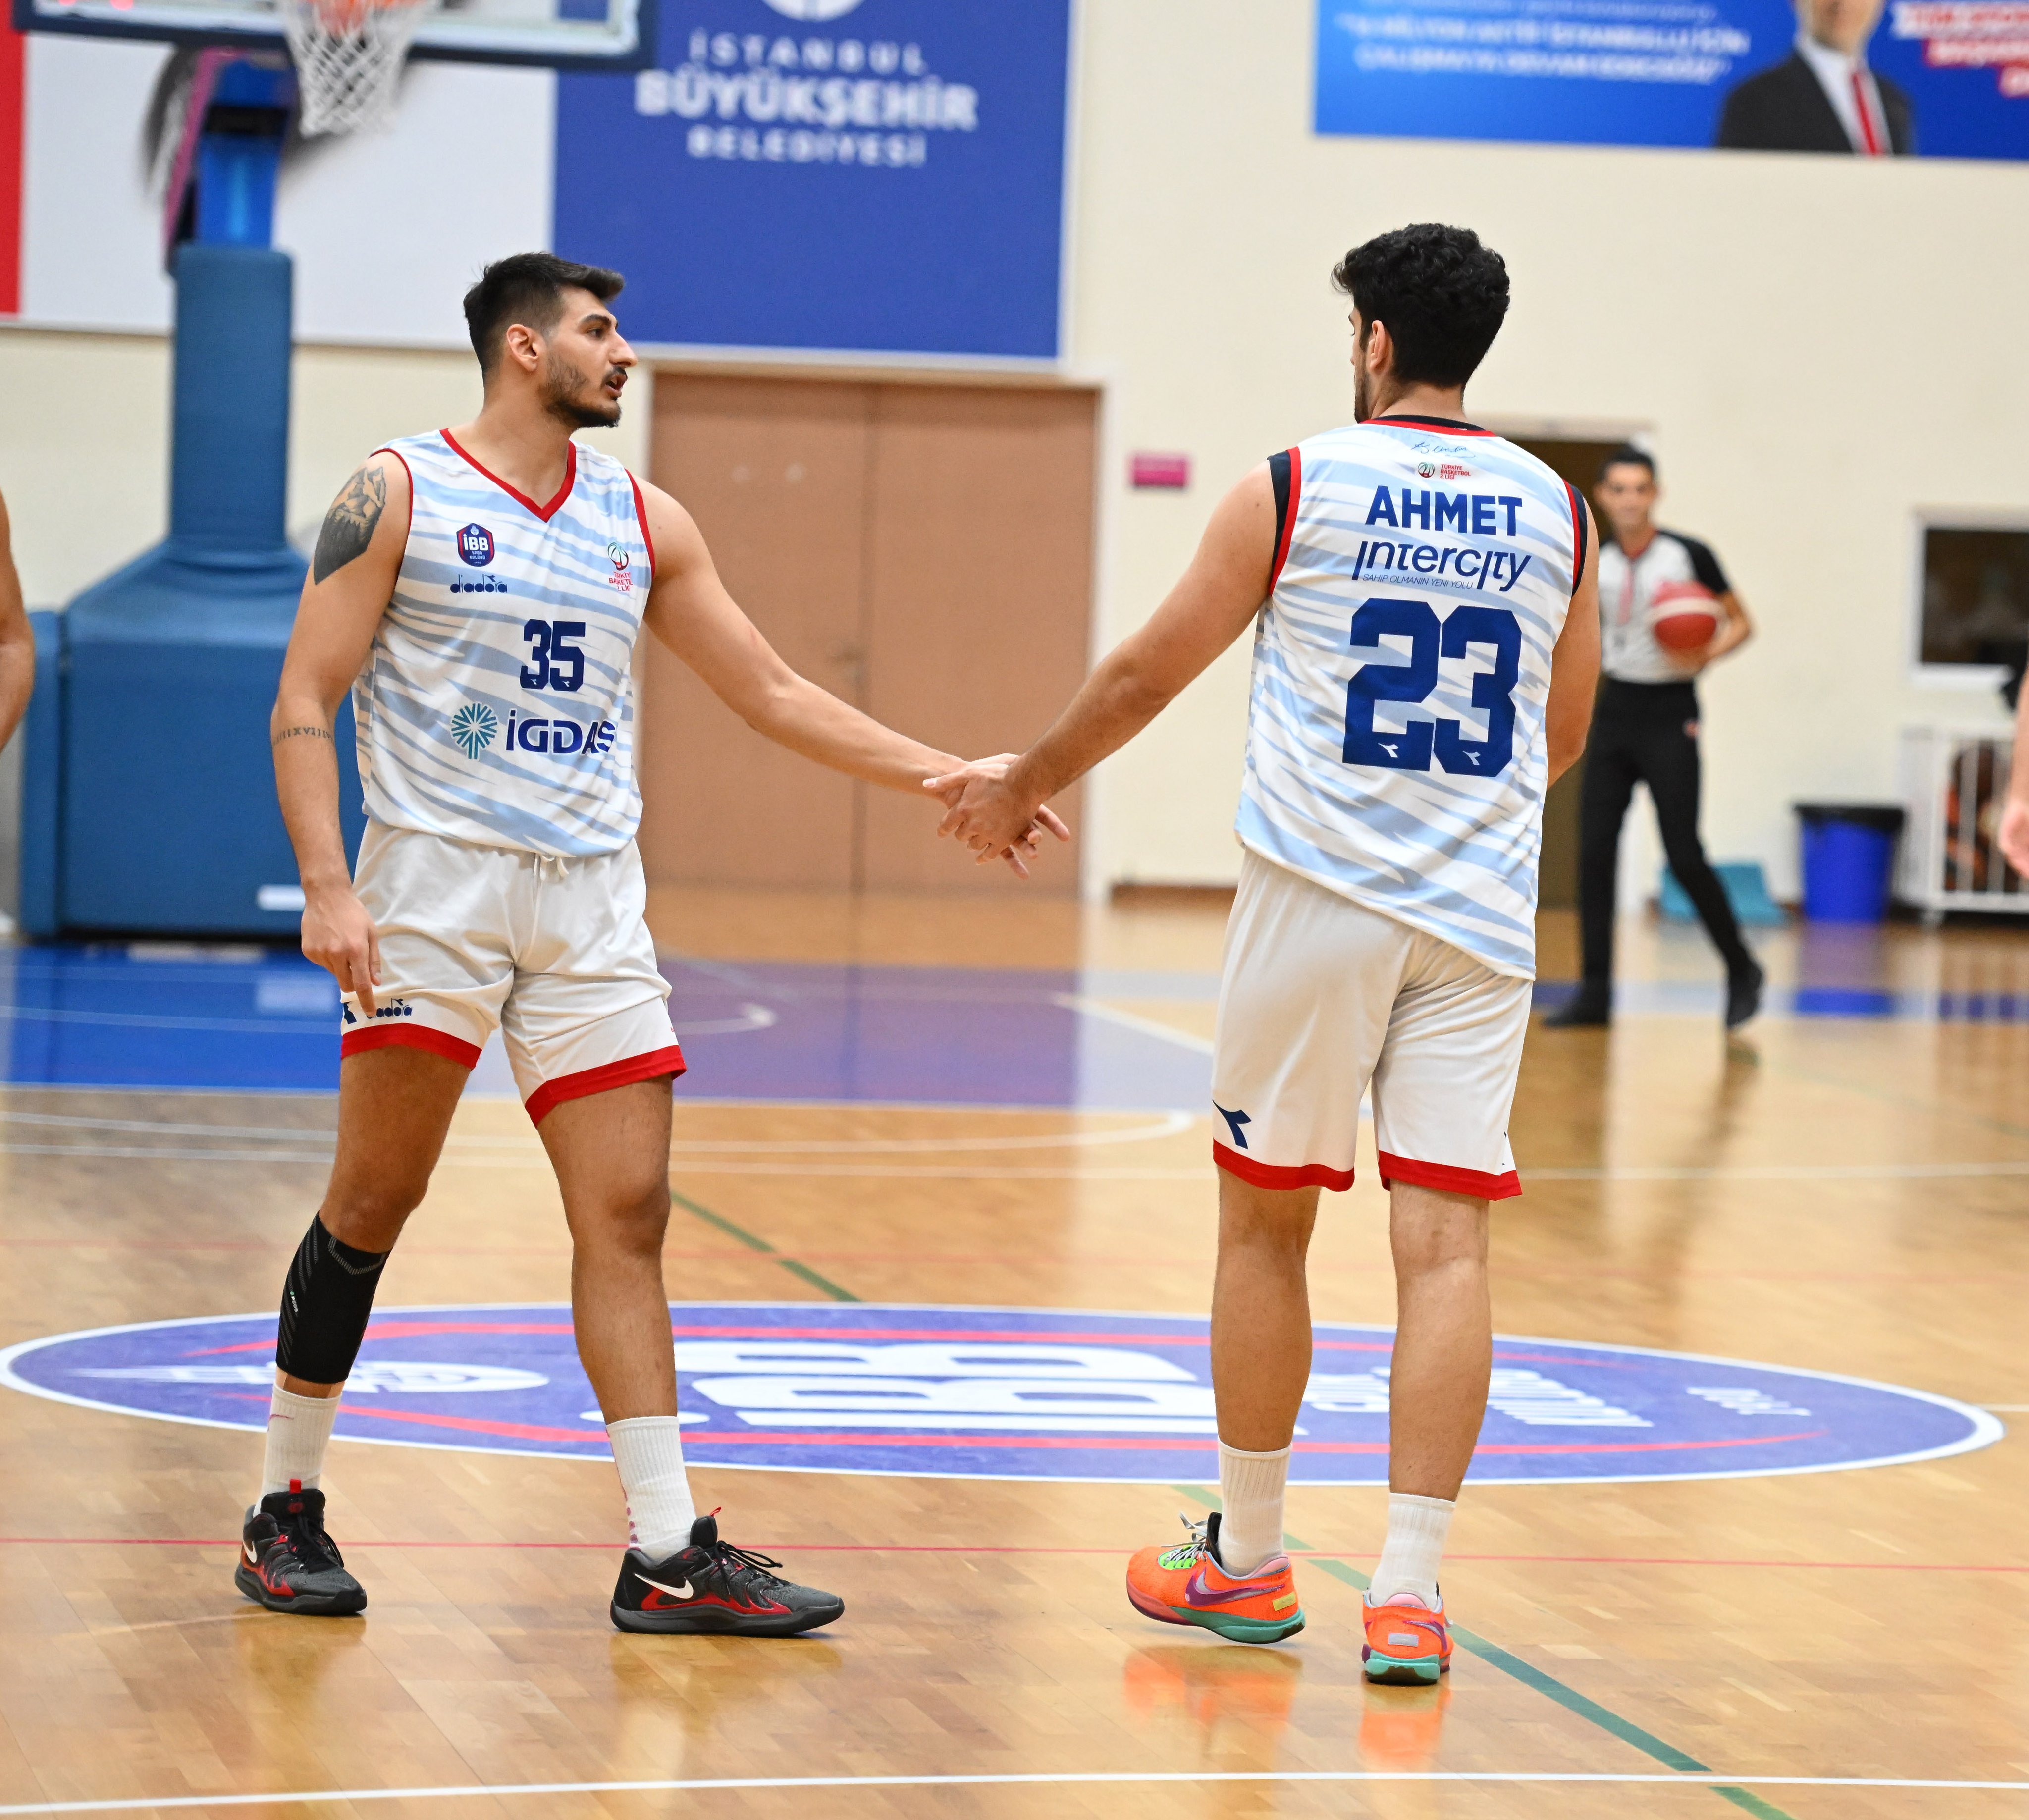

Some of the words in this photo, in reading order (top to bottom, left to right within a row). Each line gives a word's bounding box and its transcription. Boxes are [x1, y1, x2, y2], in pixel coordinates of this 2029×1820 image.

[689, 28, 927, 76] İSTANBUL
[635, 60, 978, 131] BÜYÜKŞEHİR
[1365, 485, 1522, 536] AHMET
[450, 574, 508, 593] diadora
[1362, 574, 1388, 582] SAHİP
[1389, 575, 1428, 585] OLMANIN
[1431, 578, 1449, 587] YENİ
[1451, 581, 1474, 589] YOLU
[520, 619, 586, 692] 35
[1342, 598, 1522, 778] 23
[367, 998, 413, 1019] adora
